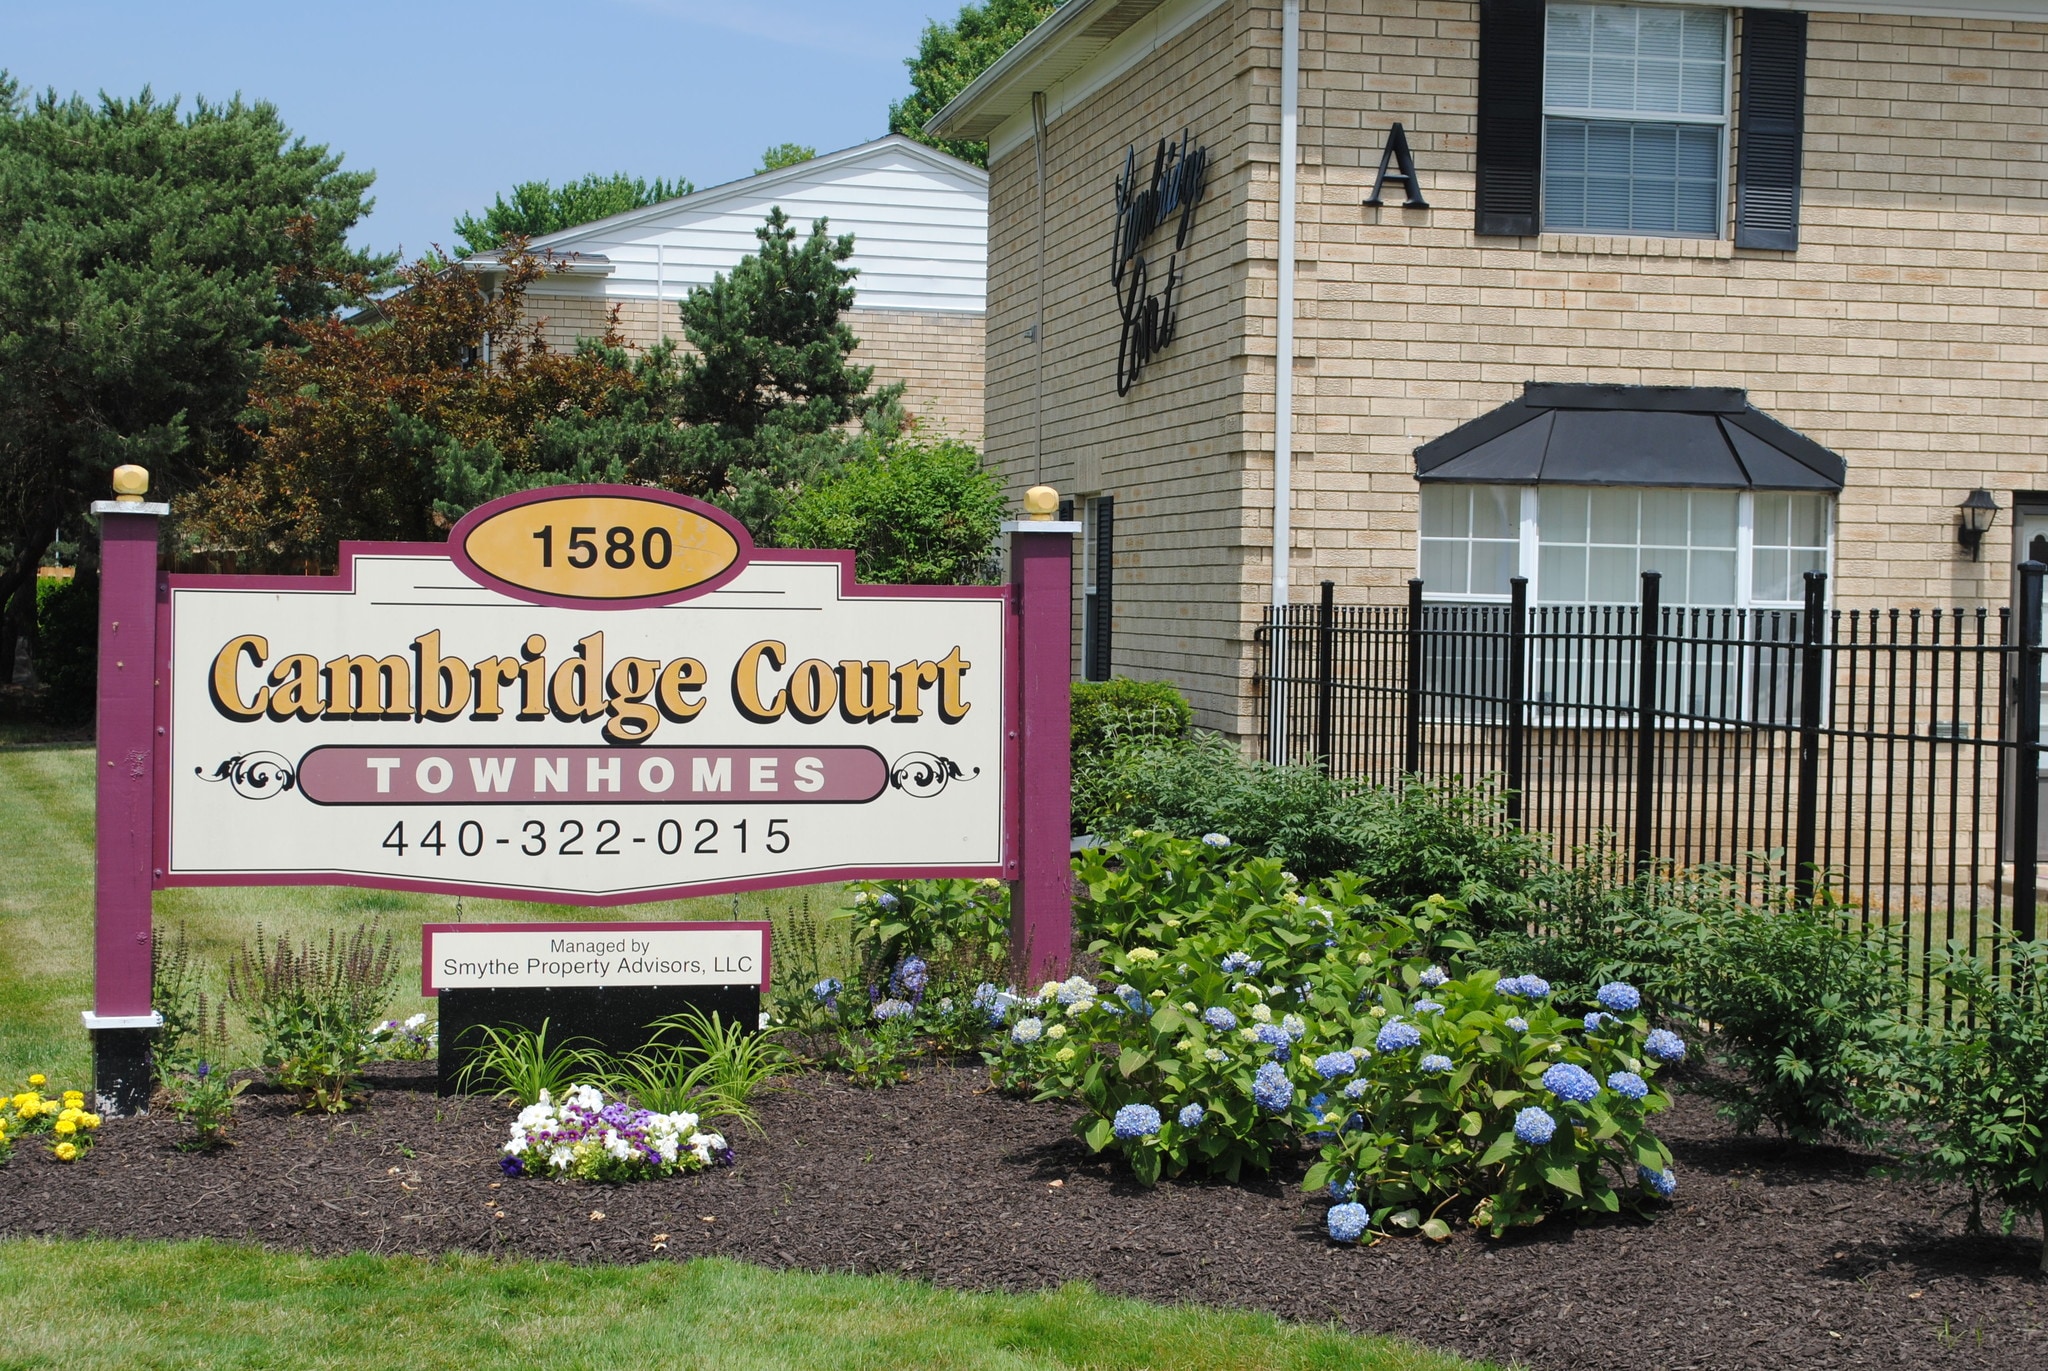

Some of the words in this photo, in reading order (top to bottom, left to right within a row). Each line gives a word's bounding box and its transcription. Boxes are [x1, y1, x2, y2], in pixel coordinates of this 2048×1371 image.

[1362, 122, 1430, 208] A
[533, 525, 673, 570] 1580
[208, 628, 708, 746] Cambridge
[731, 639, 972, 726] Court
[366, 756, 825, 794] TOWNHOMES
[382, 818, 791, 857] 440-322-0215
[550, 938, 626, 957] Managed
[631, 938, 650, 956] by
[443, 958, 519, 980] Smythe
[527, 958, 610, 978] Property
[617, 957, 706, 976] Advisors,
[714, 955, 753, 973] LLC
